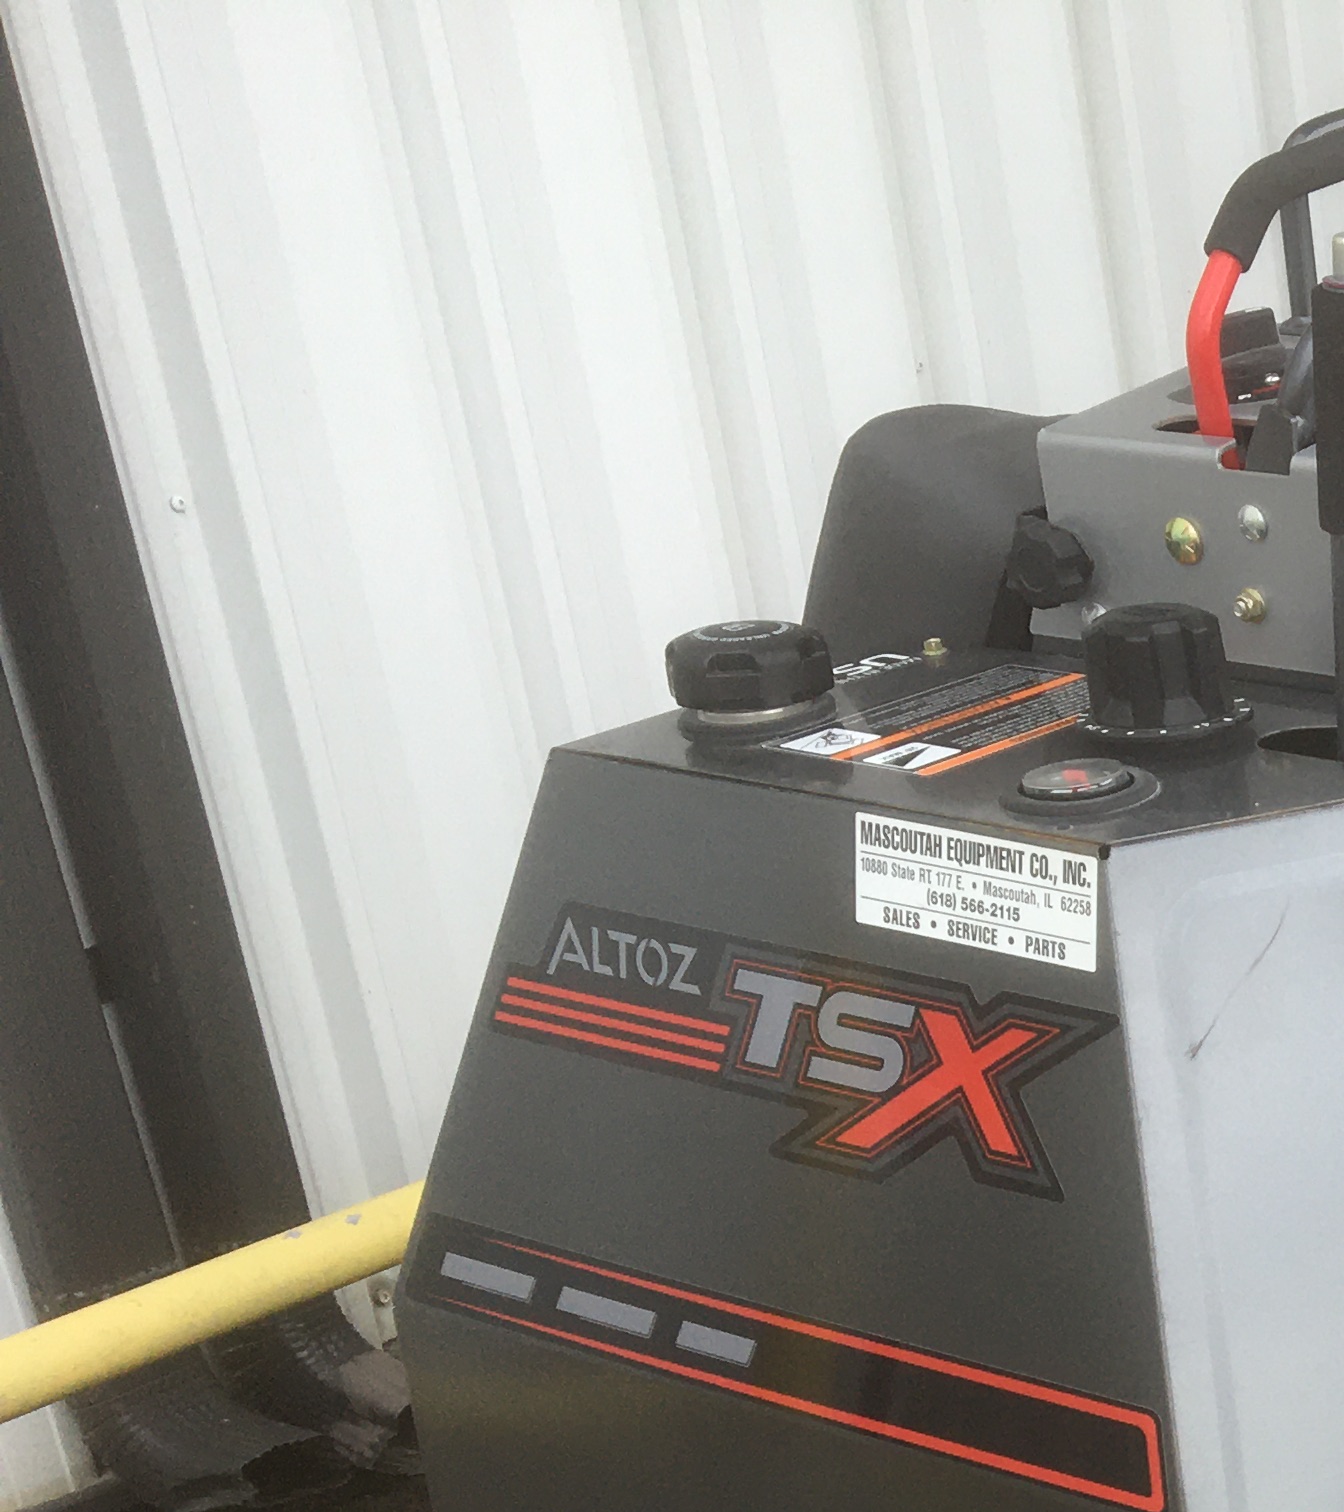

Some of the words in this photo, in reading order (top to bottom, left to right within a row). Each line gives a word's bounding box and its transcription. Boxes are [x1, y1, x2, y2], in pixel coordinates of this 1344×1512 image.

[860, 820, 942, 859] MASCOUTAH
[947, 837, 1025, 875] EQUIPMENT
[1030, 853, 1057, 885] CO.,
[1063, 859, 1091, 888] INC.
[860, 857, 888, 876] 10880
[891, 864, 915, 881] State
[936, 872, 952, 888] 177
[956, 875, 965, 891] E.
[983, 880, 1040, 908] Mascoutah,
[1044, 894, 1053, 909] IL
[1060, 896, 1091, 917] 62258
[927, 888, 956, 911] (618)
[961, 897, 1021, 922] 566-2115
[546, 916, 701, 996] ALTOZ
[883, 906, 920, 929] SALES
[947, 919, 998, 946] SERVICE
[1025, 935, 1066, 960] PARTS
[730, 964, 1050, 1162] TSX
